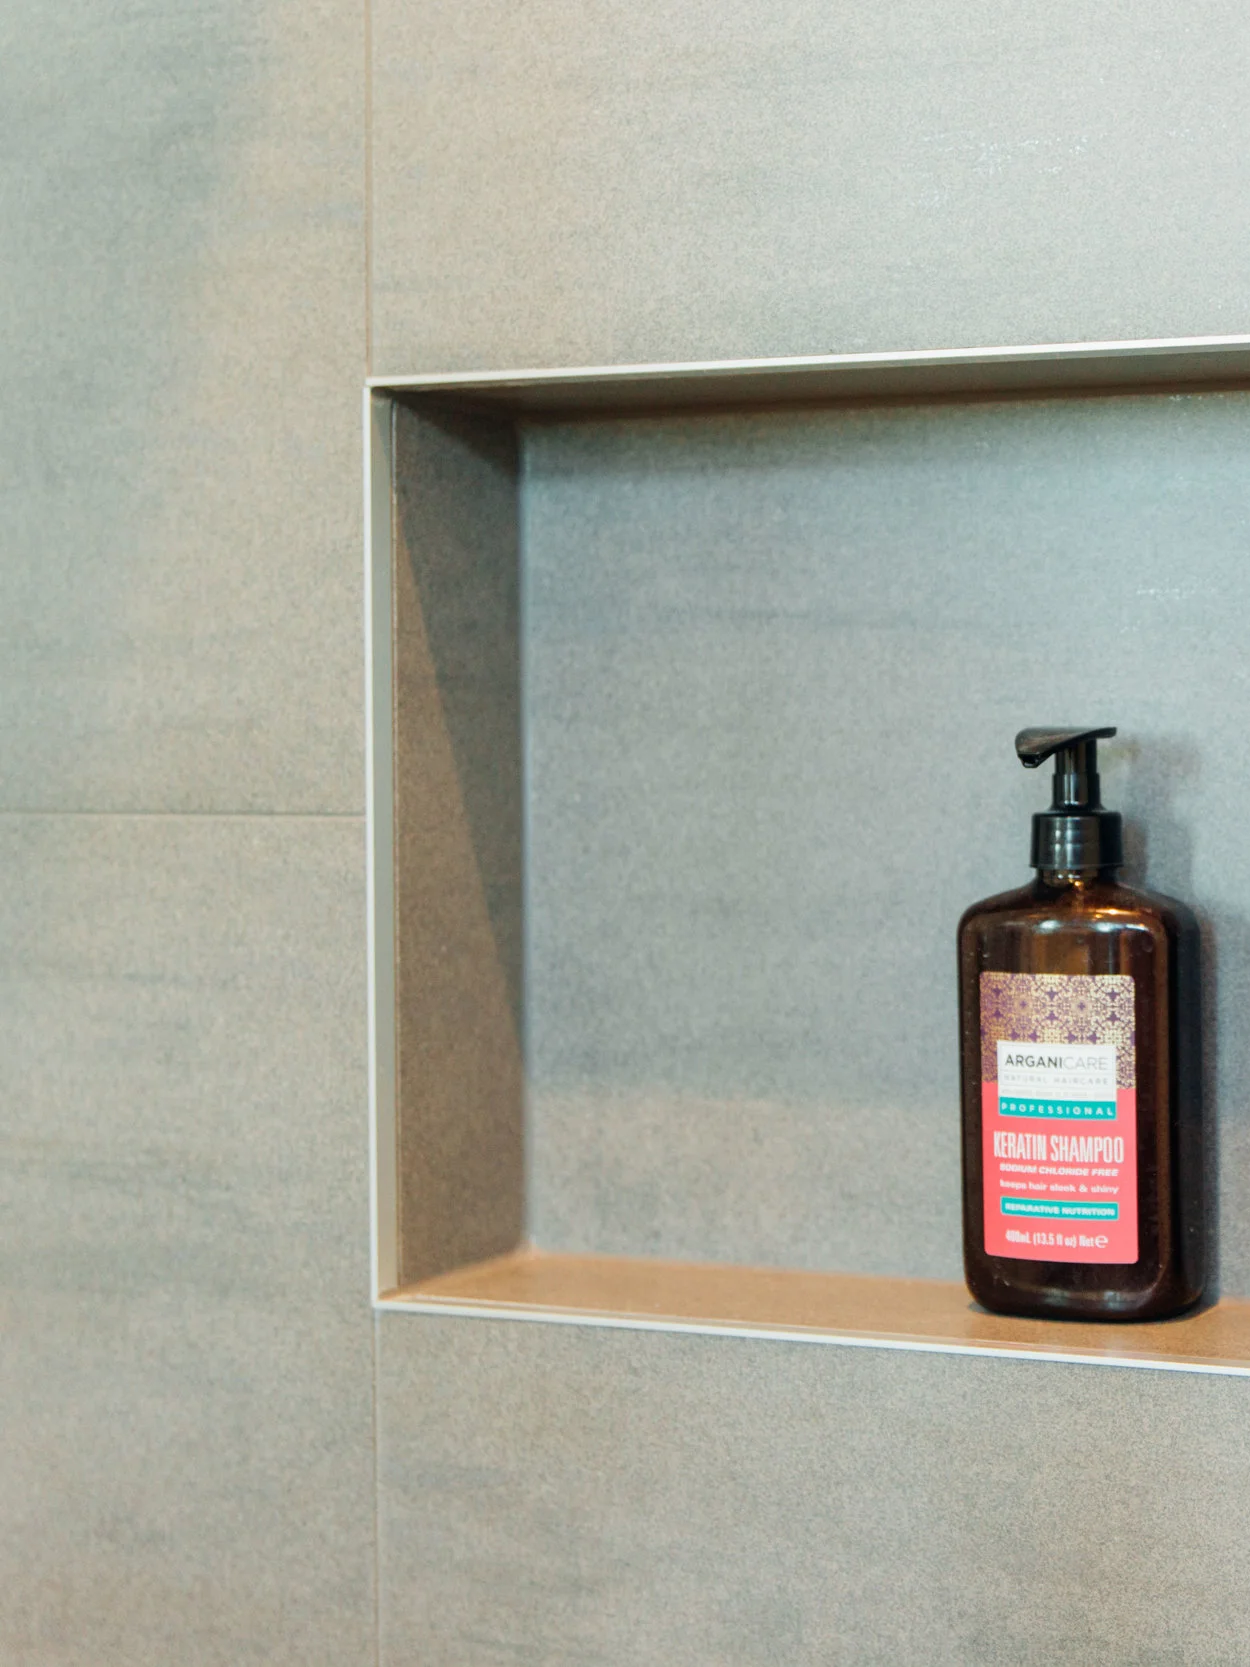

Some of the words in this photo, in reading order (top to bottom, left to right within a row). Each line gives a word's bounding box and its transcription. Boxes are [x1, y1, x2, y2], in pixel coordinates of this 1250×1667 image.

[1004, 1053, 1109, 1071] ARGANICARE
[1001, 1102, 1114, 1116] PROFESSIONAL
[993, 1131, 1047, 1161] KERATIN
[1050, 1134, 1125, 1163] SHAMPOO
[1038, 1165, 1089, 1176] CHLORIDE
[1091, 1168, 1120, 1177] FREE
[1028, 1181, 1048, 1191] hair
[1090, 1185, 1119, 1195] shiny
[1061, 1206, 1116, 1217] NUTRITION
[1033, 1231, 1055, 1246] (13.5
